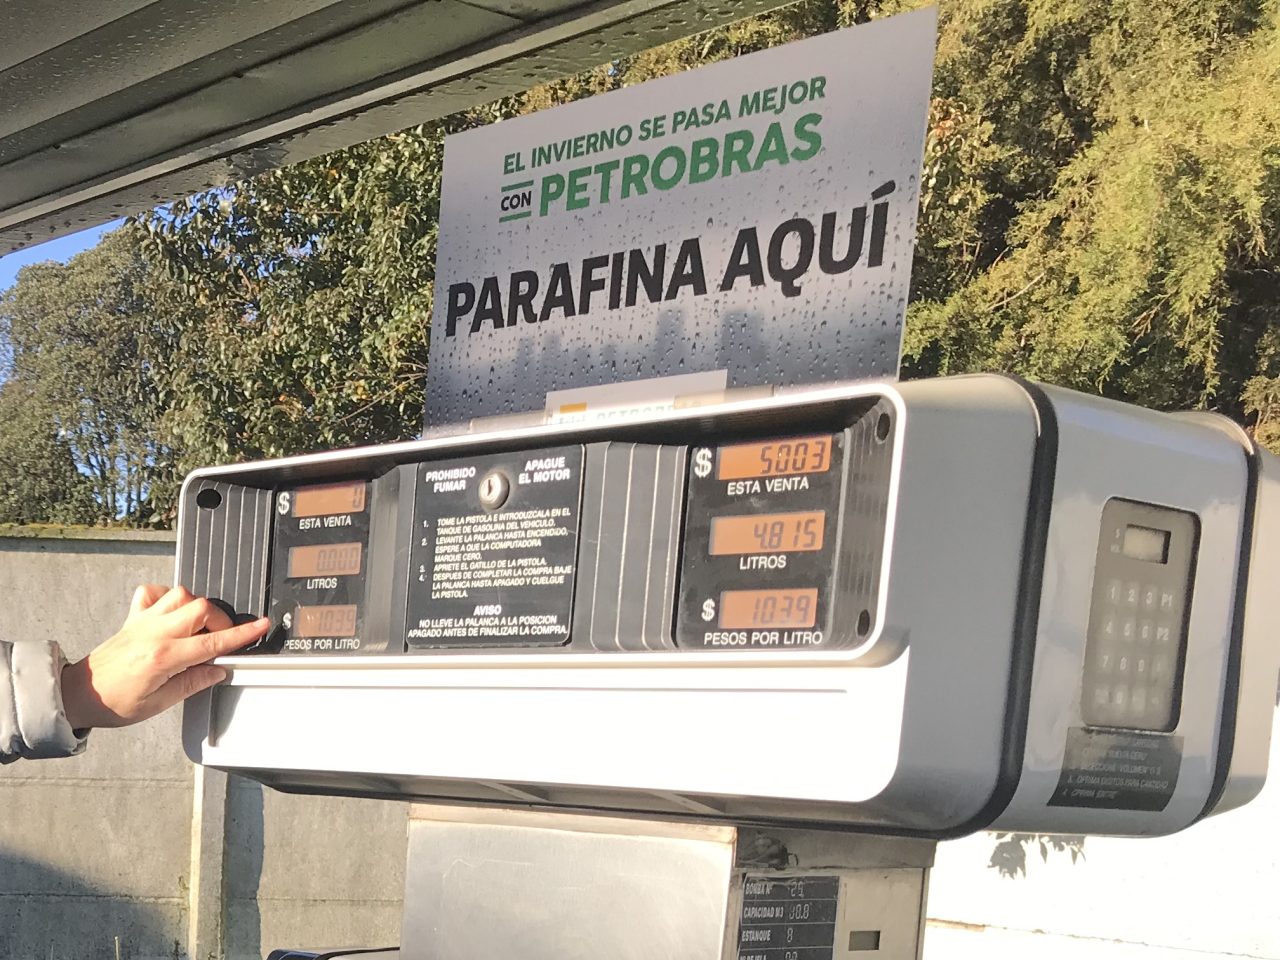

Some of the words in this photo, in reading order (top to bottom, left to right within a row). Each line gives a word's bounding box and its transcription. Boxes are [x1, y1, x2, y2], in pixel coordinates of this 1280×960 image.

[503, 153, 526, 174] EL
[531, 125, 633, 168] INVIERNO
[639, 115, 666, 141] SE
[672, 100, 732, 134] PASA
[738, 76, 826, 117] MEJOR
[500, 191, 532, 211] CON
[539, 112, 823, 217] PETROBRAS
[445, 237, 707, 338] PARAFINA
[720, 179, 896, 298] AQUÍ
[525, 457, 565, 472] APAGUE
[760, 441, 826, 474] 5003
[426, 467, 477, 482] PROHIBIDO
[518, 473, 531, 485] EL
[533, 468, 570, 483] MOTOR
[434, 480, 466, 493] FUMAR
[727, 481, 761, 495] ESTA
[765, 477, 809, 493] VENTA
[299, 518, 322, 530] ESTA
[324, 516, 351, 528] VENTA
[438, 517, 456, 527] TOME
[465, 514, 492, 524] PISTOLA
[562, 507, 571, 516] EL
[437, 526, 462, 535] TANQUE
[462, 525, 472, 534] DE
[472, 522, 505, 532] GASOLINA
[506, 521, 519, 530] DEL
[436, 535, 464, 545] LEVANTE
[464, 534, 473, 543] LA
[473, 532, 503, 542] PALANCA
[504, 530, 525, 539] HASTA
[435, 545, 460, 554] ESPERE
[466, 543, 480, 552] QUE
[481, 542, 489, 551] LA
[490, 539, 541, 550] COMPUTADORA
[433, 563, 460, 572] APRIETE
[460, 562, 469, 570] EL
[470, 560, 496, 570] GATILLO
[497, 560, 506, 568] DE
[507, 559, 516, 568] LA
[434, 553, 462, 563] MARQUE
[739, 555, 787, 570] LITROS
[433, 571, 462, 581] DESPUES
[463, 571, 472, 579] DE
[473, 568, 512, 579] COMPLETAR
[513, 568, 522, 576] LA
[523, 566, 553, 576] COMPRA
[307, 578, 337, 589] LITROS
[432, 582, 441, 590] LA
[441, 580, 470, 589] PALANCA
[471, 579, 492, 588] HASTA
[493, 577, 525, 587] APAGADO
[532, 575, 564, 585] CUELGUE
[431, 591, 440, 599] LA
[473, 605, 502, 616] AVISO
[752, 595, 810, 625] 1039
[419, 619, 430, 628] NO
[431, 618, 453, 628] LLEVE
[454, 618, 463, 627] LA
[465, 617, 499, 627] PALANCA
[500, 617, 506, 626] A
[507, 616, 517, 625] LA
[519, 615, 557, 625] POSICION
[408, 629, 442, 638] APAGADO
[442, 628, 467, 637] ANTES
[468, 627, 478, 636] DE
[480, 626, 518, 636] FINALIZAR
[520, 626, 530, 635] LA
[704, 632, 747, 645] PESOS
[751, 632, 778, 645] POR
[784, 631, 823, 645] LITRO
[284, 639, 312, 650] PESOS
[314, 639, 332, 649] POR
[335, 639, 360, 649] LITRO
[743, 906, 774, 919] CAPACIDAD
[741, 930, 771, 942] ESTANQUE
